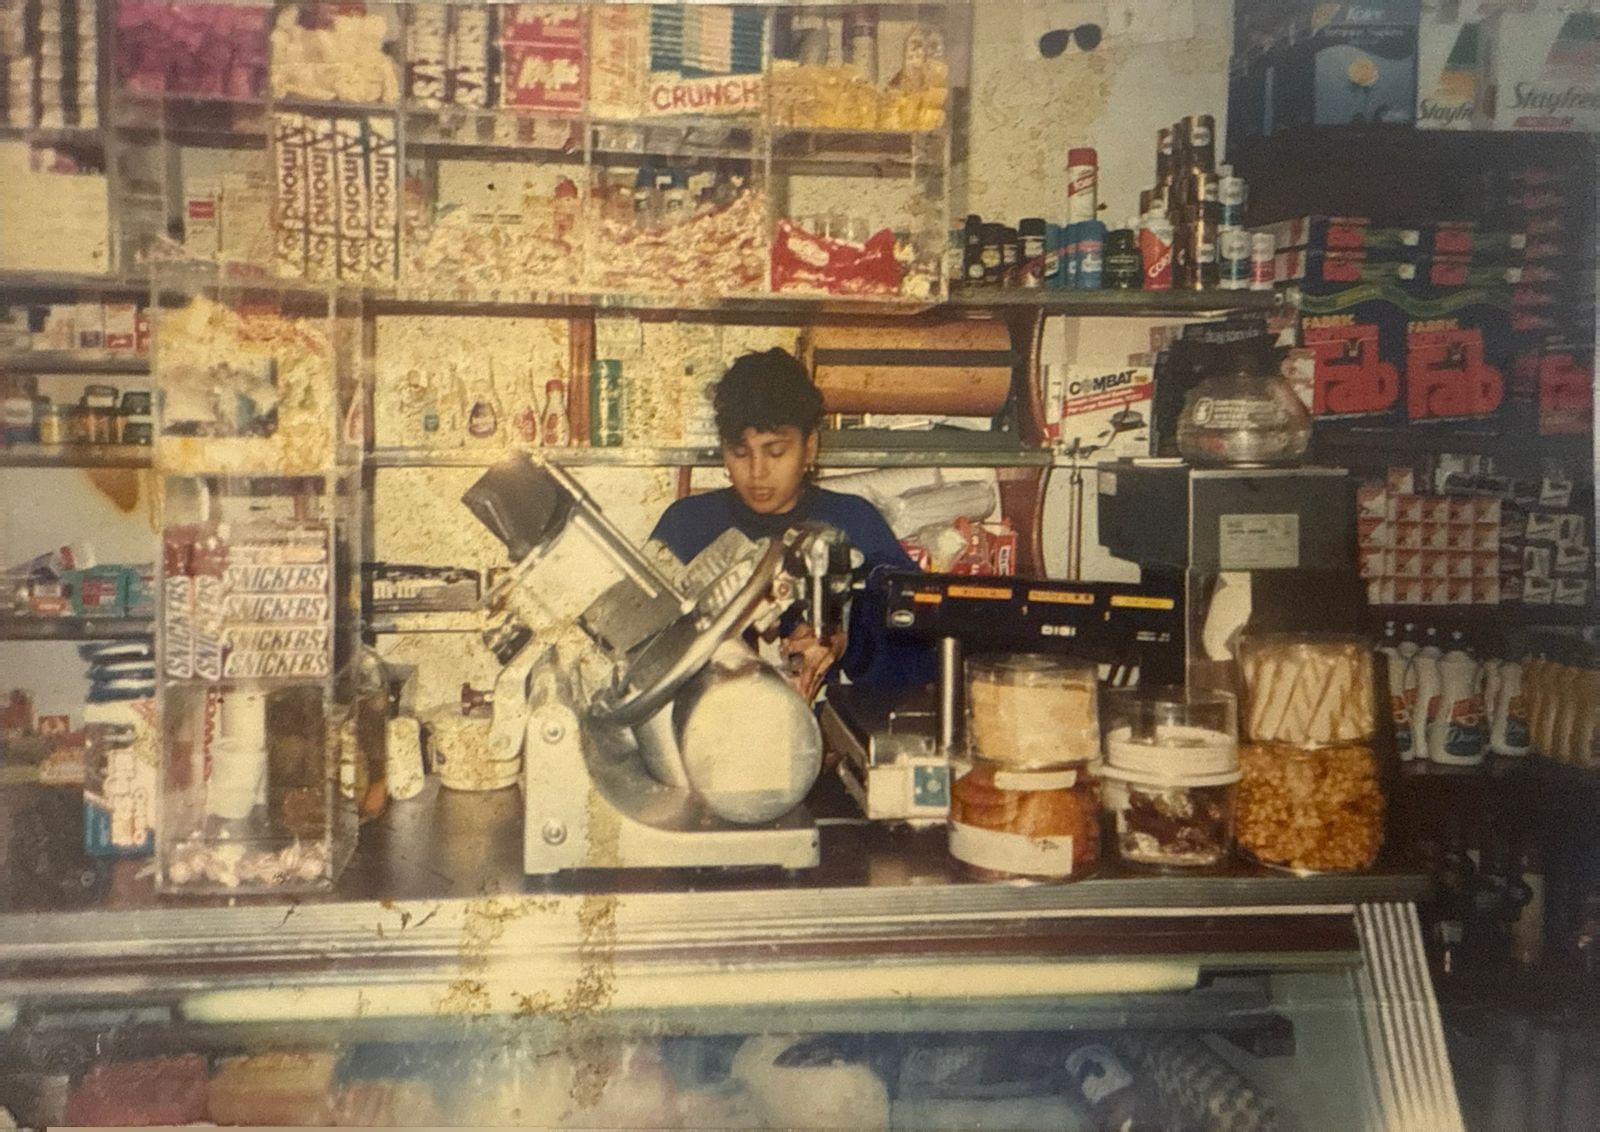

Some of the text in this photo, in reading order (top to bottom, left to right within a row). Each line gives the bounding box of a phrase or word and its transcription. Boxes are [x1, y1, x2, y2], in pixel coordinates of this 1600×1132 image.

[652, 80, 761, 110] CRUNCH
[275, 127, 304, 219] Almond
[305, 129, 334, 225] Almond
[335, 132, 364, 230] Almond
[369, 131, 397, 230] Almond
[226, 565, 323, 591] SNICKERS
[226, 597, 322, 618] SNICKERS
[226, 628, 323, 650] SNICKERS
[227, 650, 328, 676] SNICKERS
